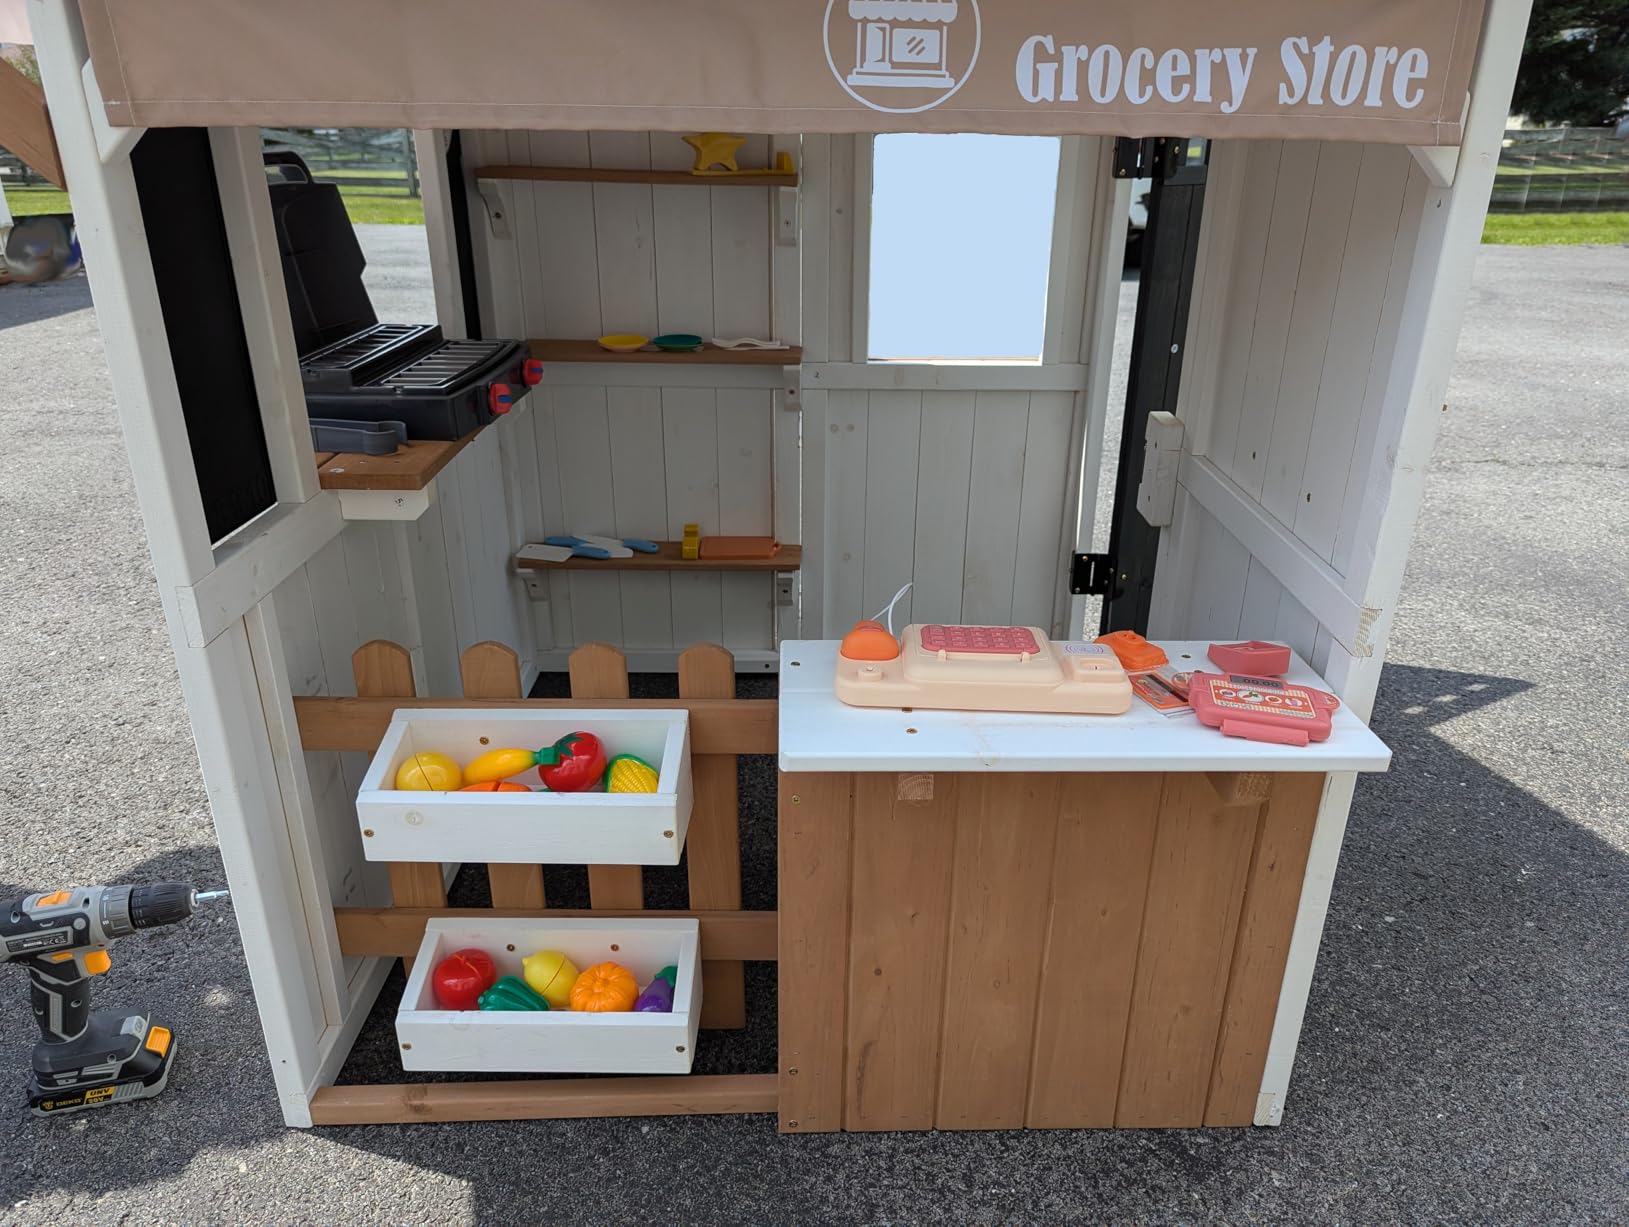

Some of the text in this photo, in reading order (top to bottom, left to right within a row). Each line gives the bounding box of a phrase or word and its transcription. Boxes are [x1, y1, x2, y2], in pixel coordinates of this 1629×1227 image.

[1016, 35, 1429, 114] Grocery Store
[90, 1088, 110, 1097] UNV
